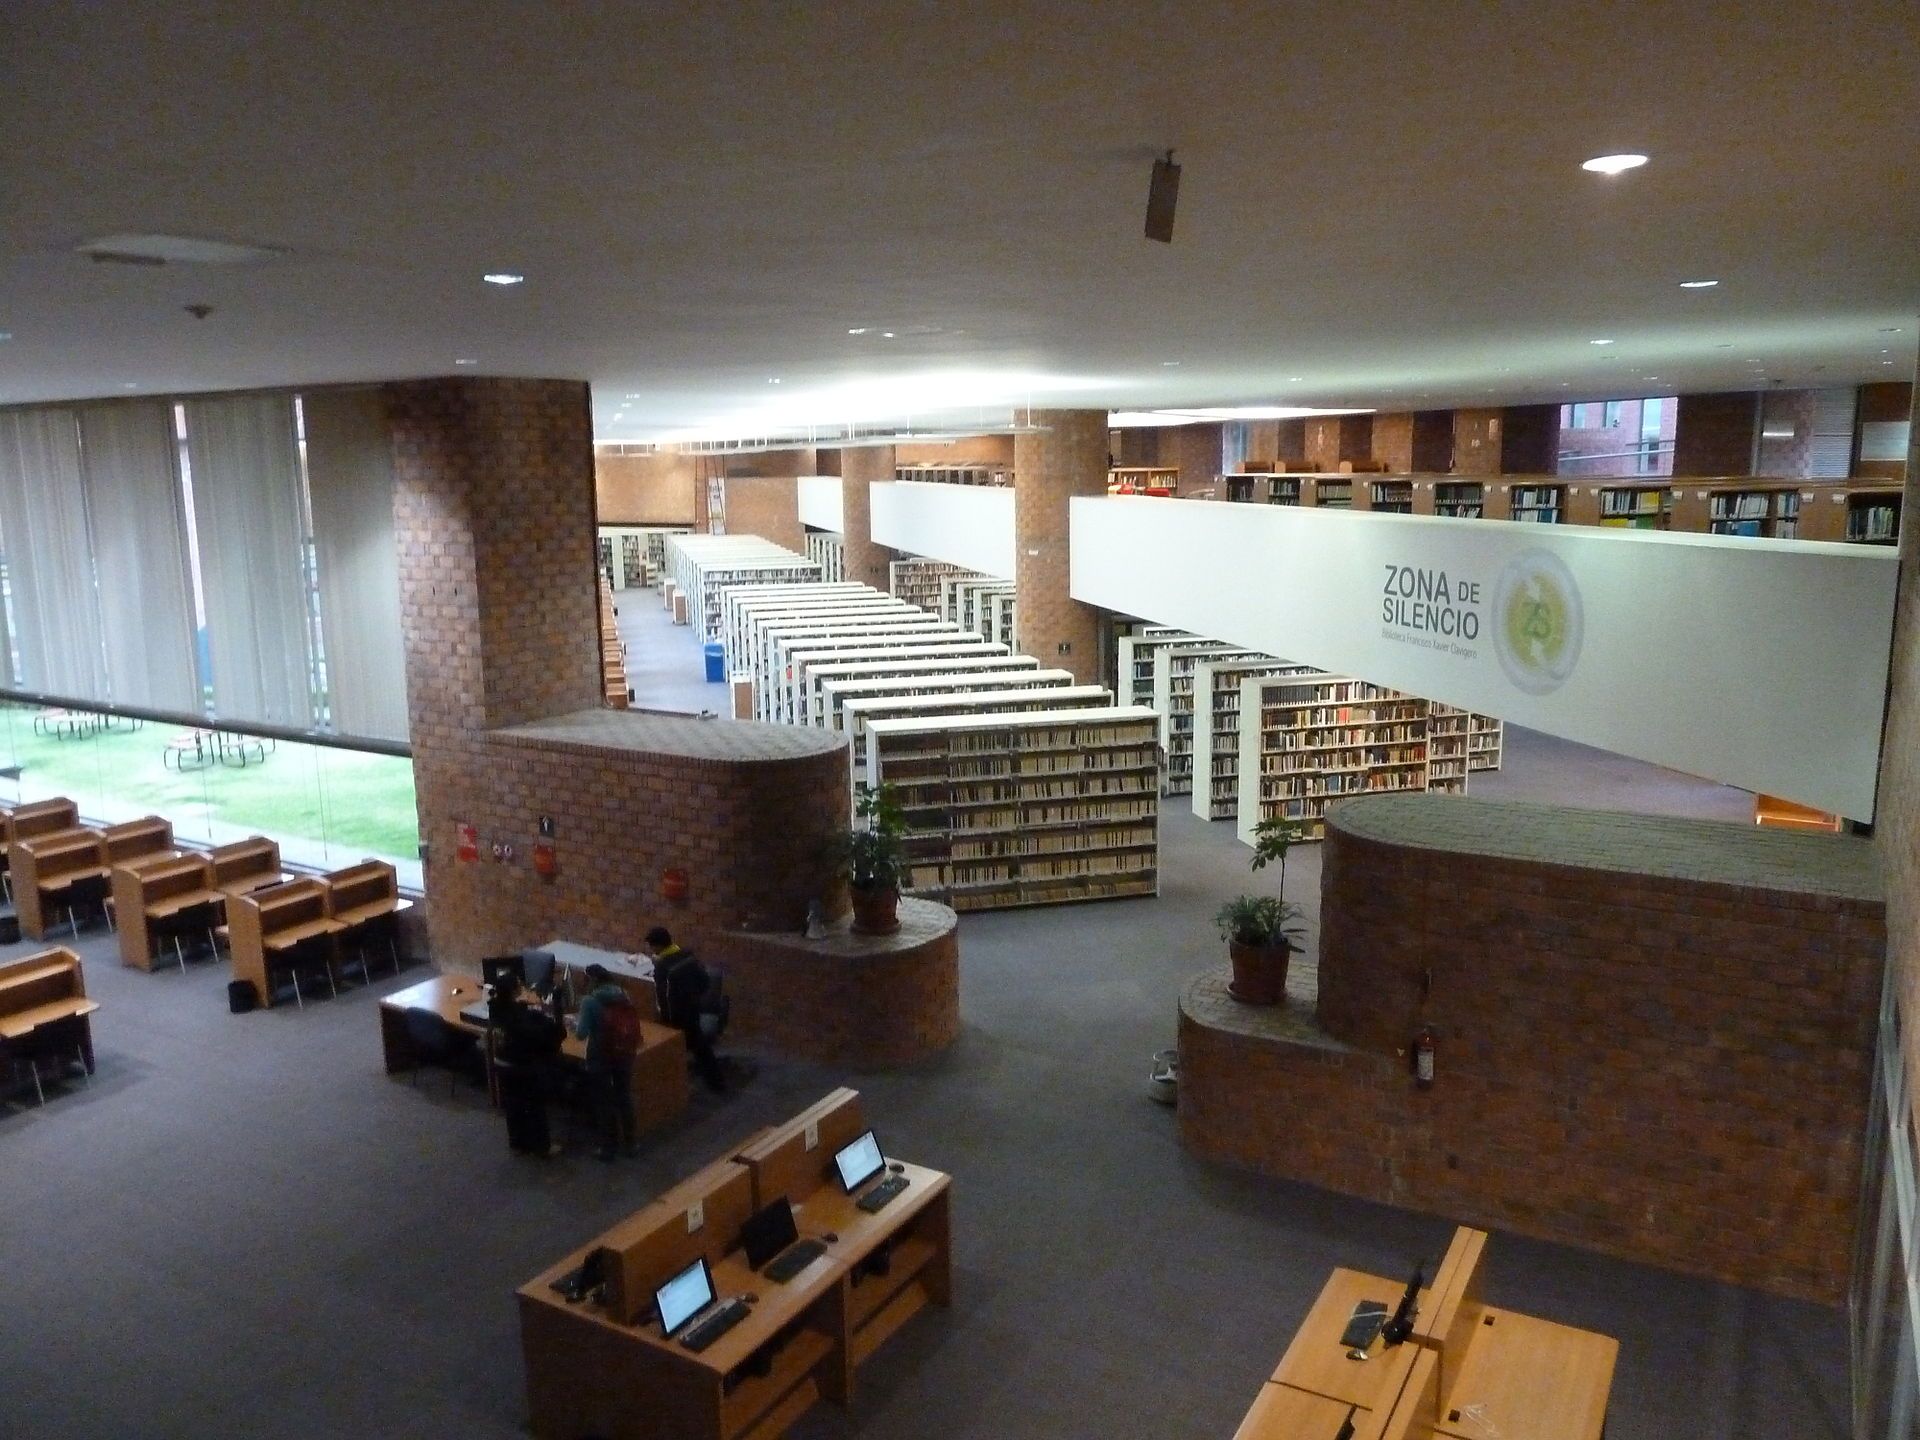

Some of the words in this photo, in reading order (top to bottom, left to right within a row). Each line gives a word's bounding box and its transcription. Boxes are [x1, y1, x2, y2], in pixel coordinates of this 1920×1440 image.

[1384, 565, 1450, 604] ZONA
[1458, 581, 1480, 604] DE
[1383, 598, 1478, 639] SILENCIO
[1382, 628, 1405, 642] Biblioteca
[1406, 632, 1432, 648] Francisco
[1432, 639, 1449, 653] Xavier
[1450, 643, 1477, 660] Clavigero
